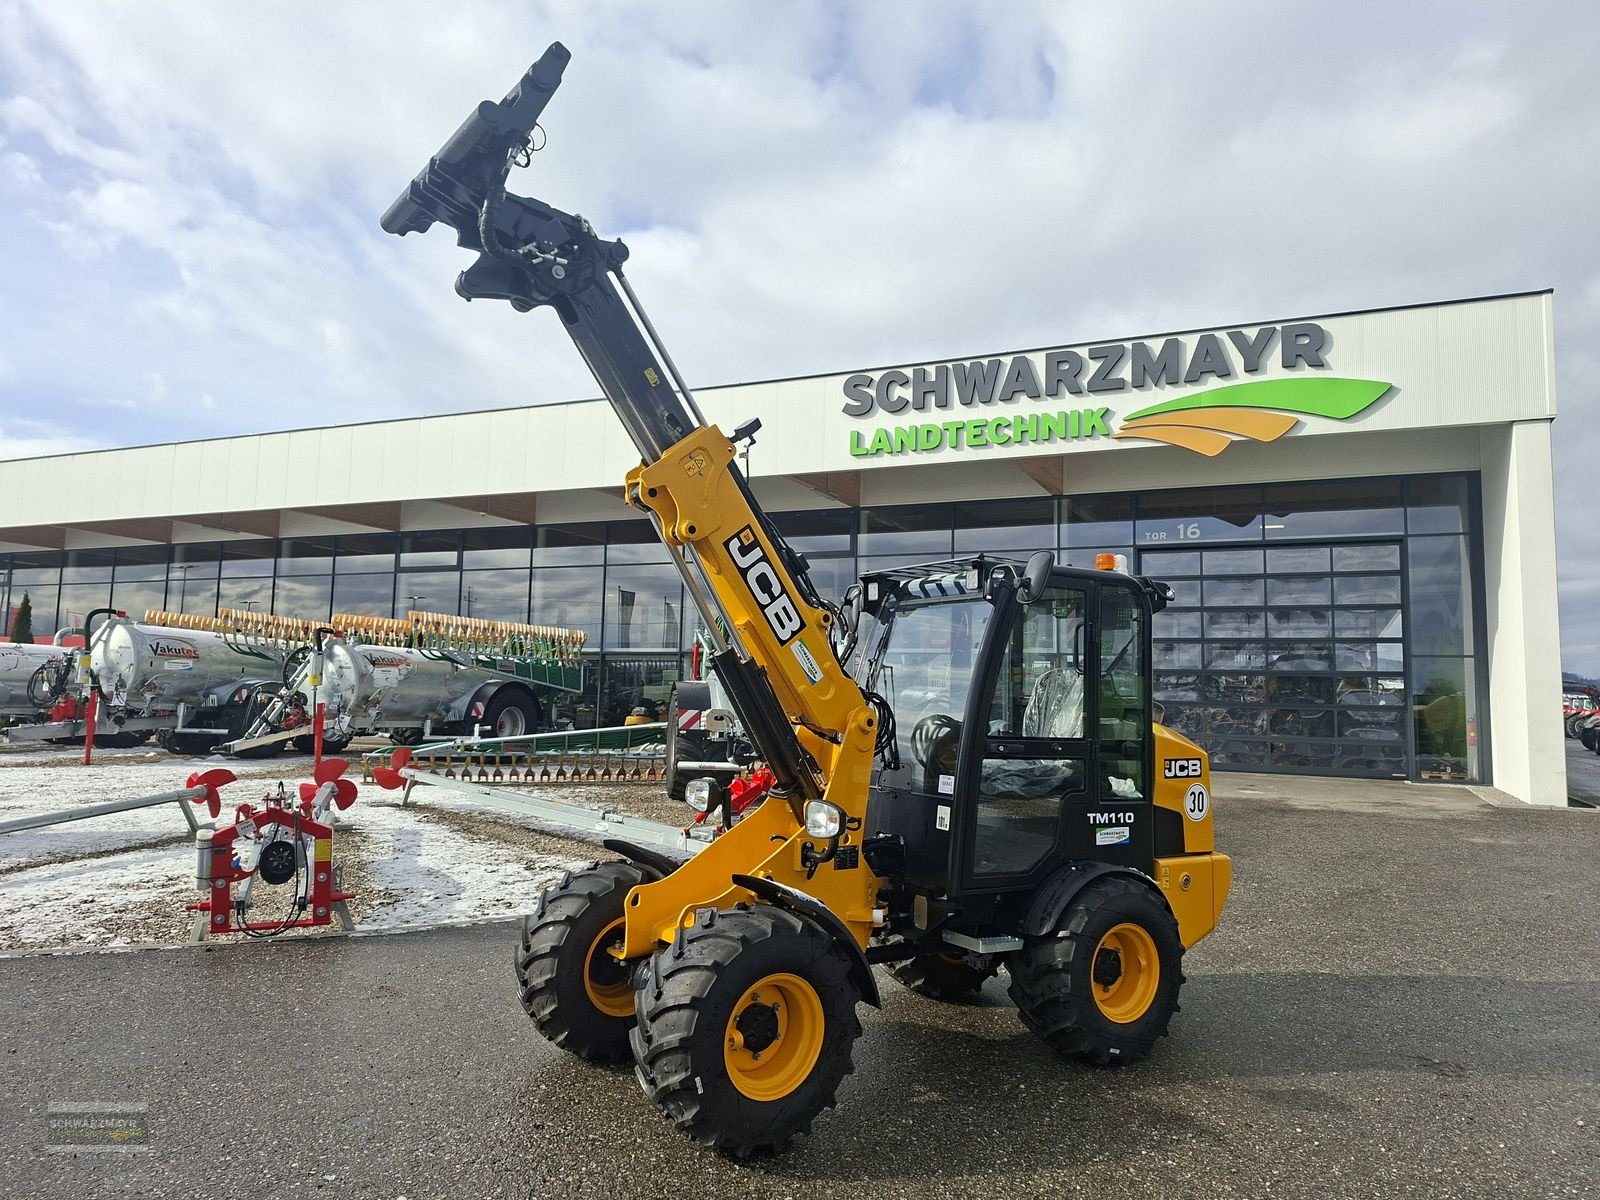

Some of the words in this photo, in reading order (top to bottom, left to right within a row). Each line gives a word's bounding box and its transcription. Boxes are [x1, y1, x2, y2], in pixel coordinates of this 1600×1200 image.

[842, 322, 1326, 417] SCHWARZMAYR
[849, 407, 1110, 456] LANDTECHNIK
[1145, 532, 1167, 540] TOR
[1177, 523, 1201, 540] 16
[729, 537, 801, 642] JCB
[149, 642, 200, 656] Vakutec
[363, 653, 411, 666] Vakutec
[1165, 760, 1201, 777] JCB
[1189, 791, 1204, 813] 30
[1087, 812, 1135, 825] TM110
